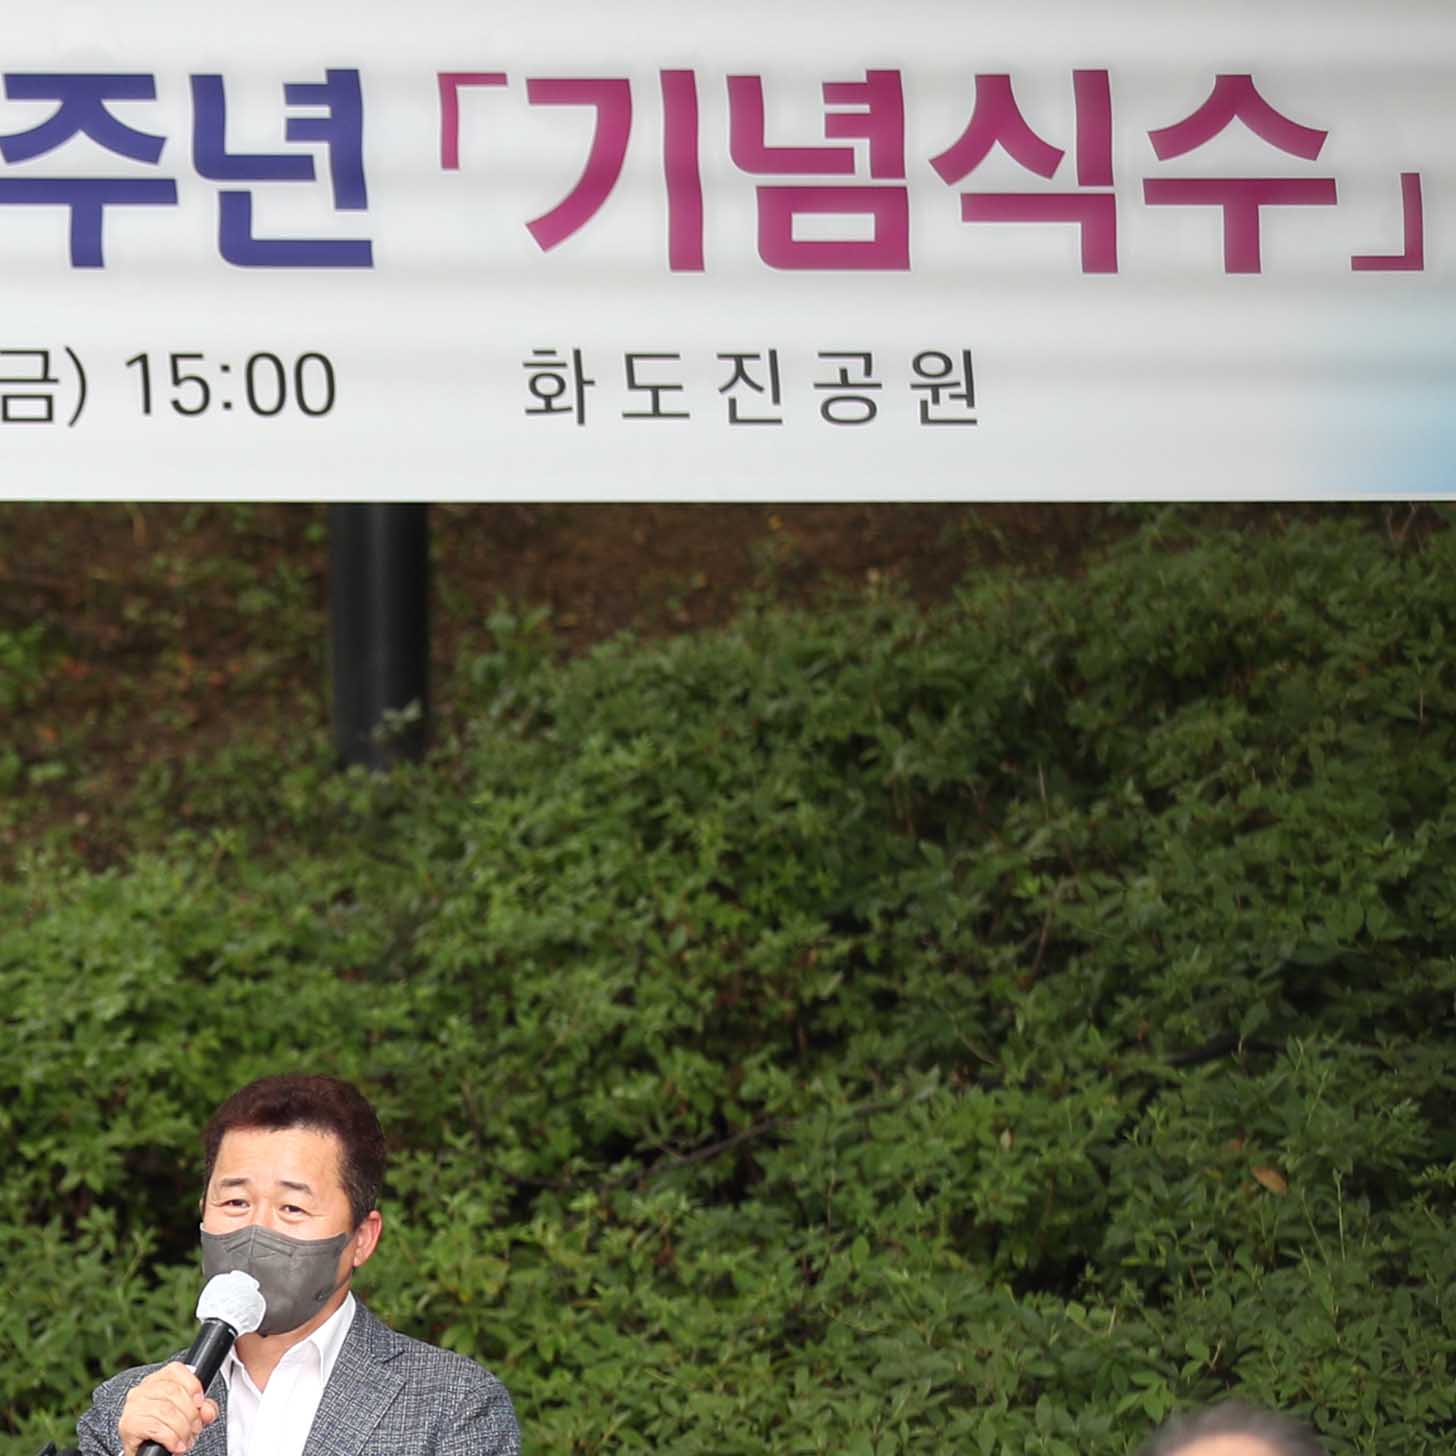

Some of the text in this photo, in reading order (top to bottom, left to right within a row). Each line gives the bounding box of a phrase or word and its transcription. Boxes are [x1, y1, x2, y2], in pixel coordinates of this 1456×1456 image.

[437, 69, 1426, 275] 「기념식수」
[126, 352, 337, 418] 15:00
[523, 348, 979, 426] 화도진공원
